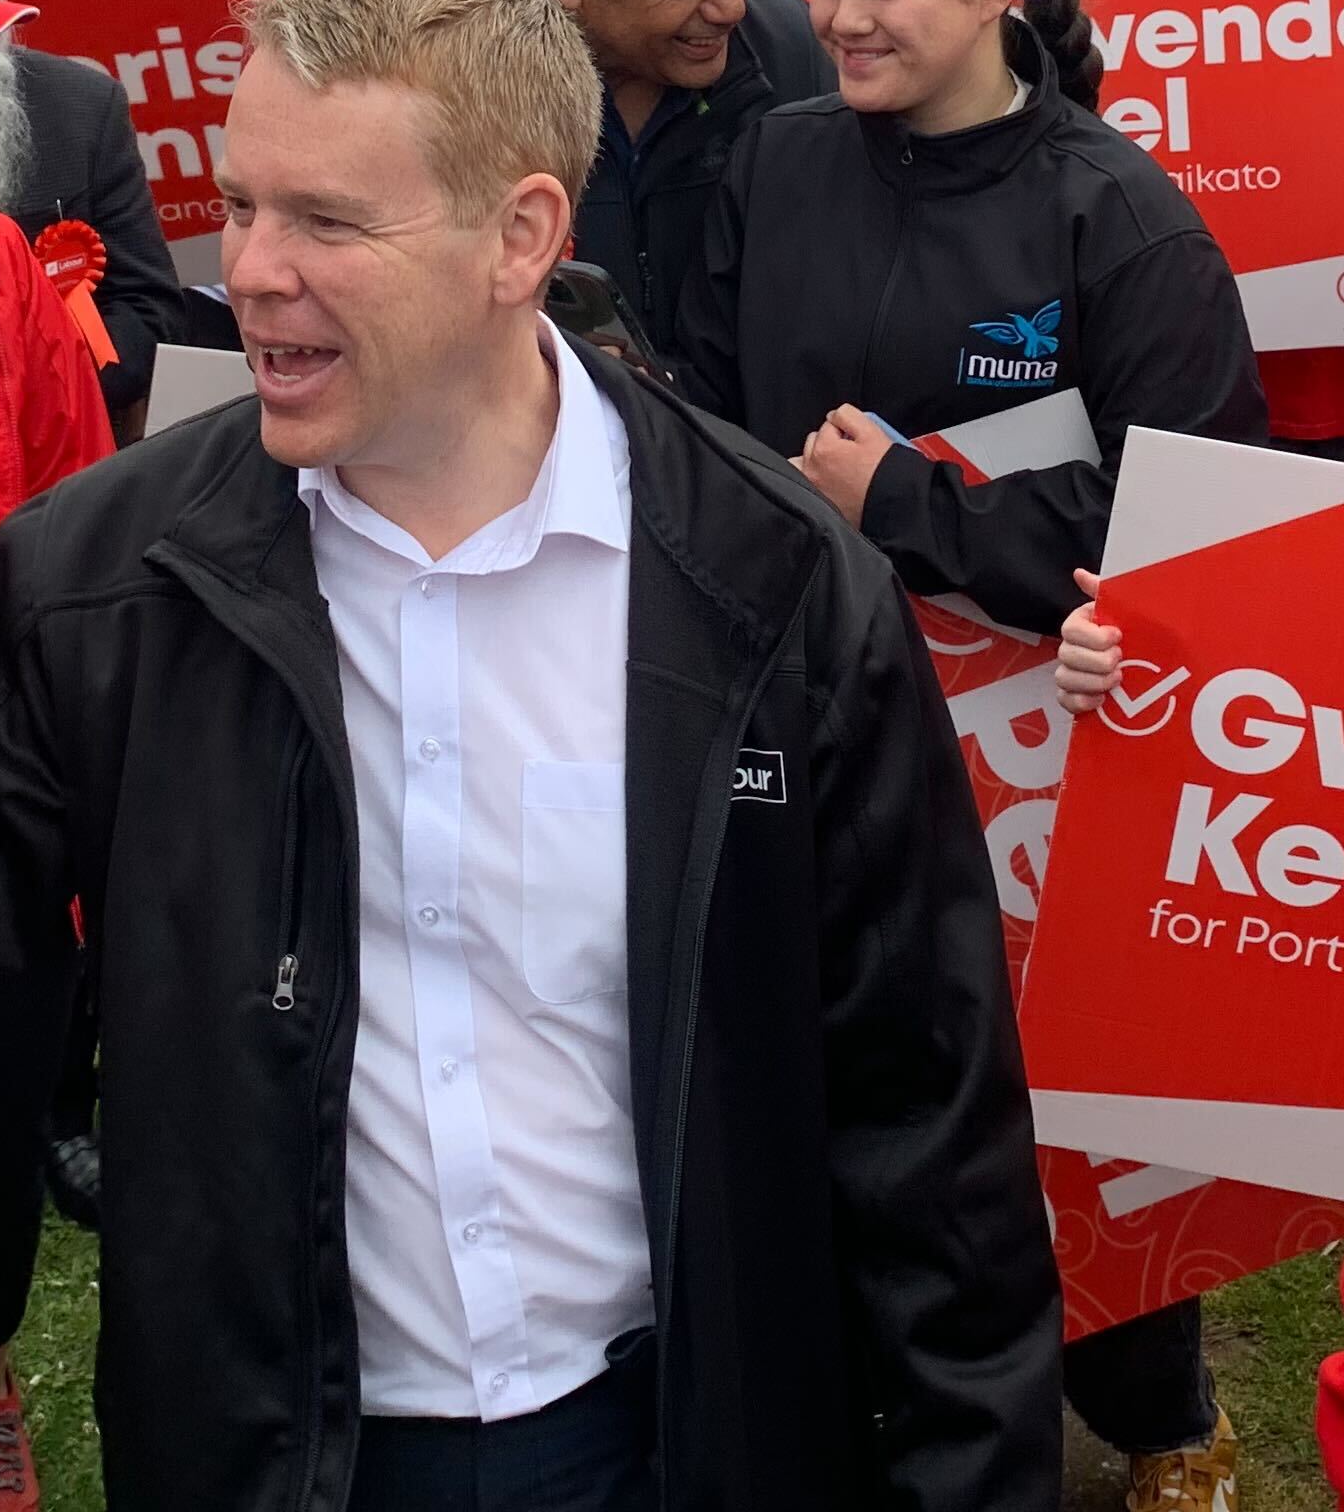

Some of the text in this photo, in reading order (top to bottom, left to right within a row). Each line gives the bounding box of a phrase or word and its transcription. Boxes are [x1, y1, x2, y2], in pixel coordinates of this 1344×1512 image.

[968, 355, 1058, 380] muma
[1148, 899, 1226, 949] for
[1236, 917, 1344, 973] Port
